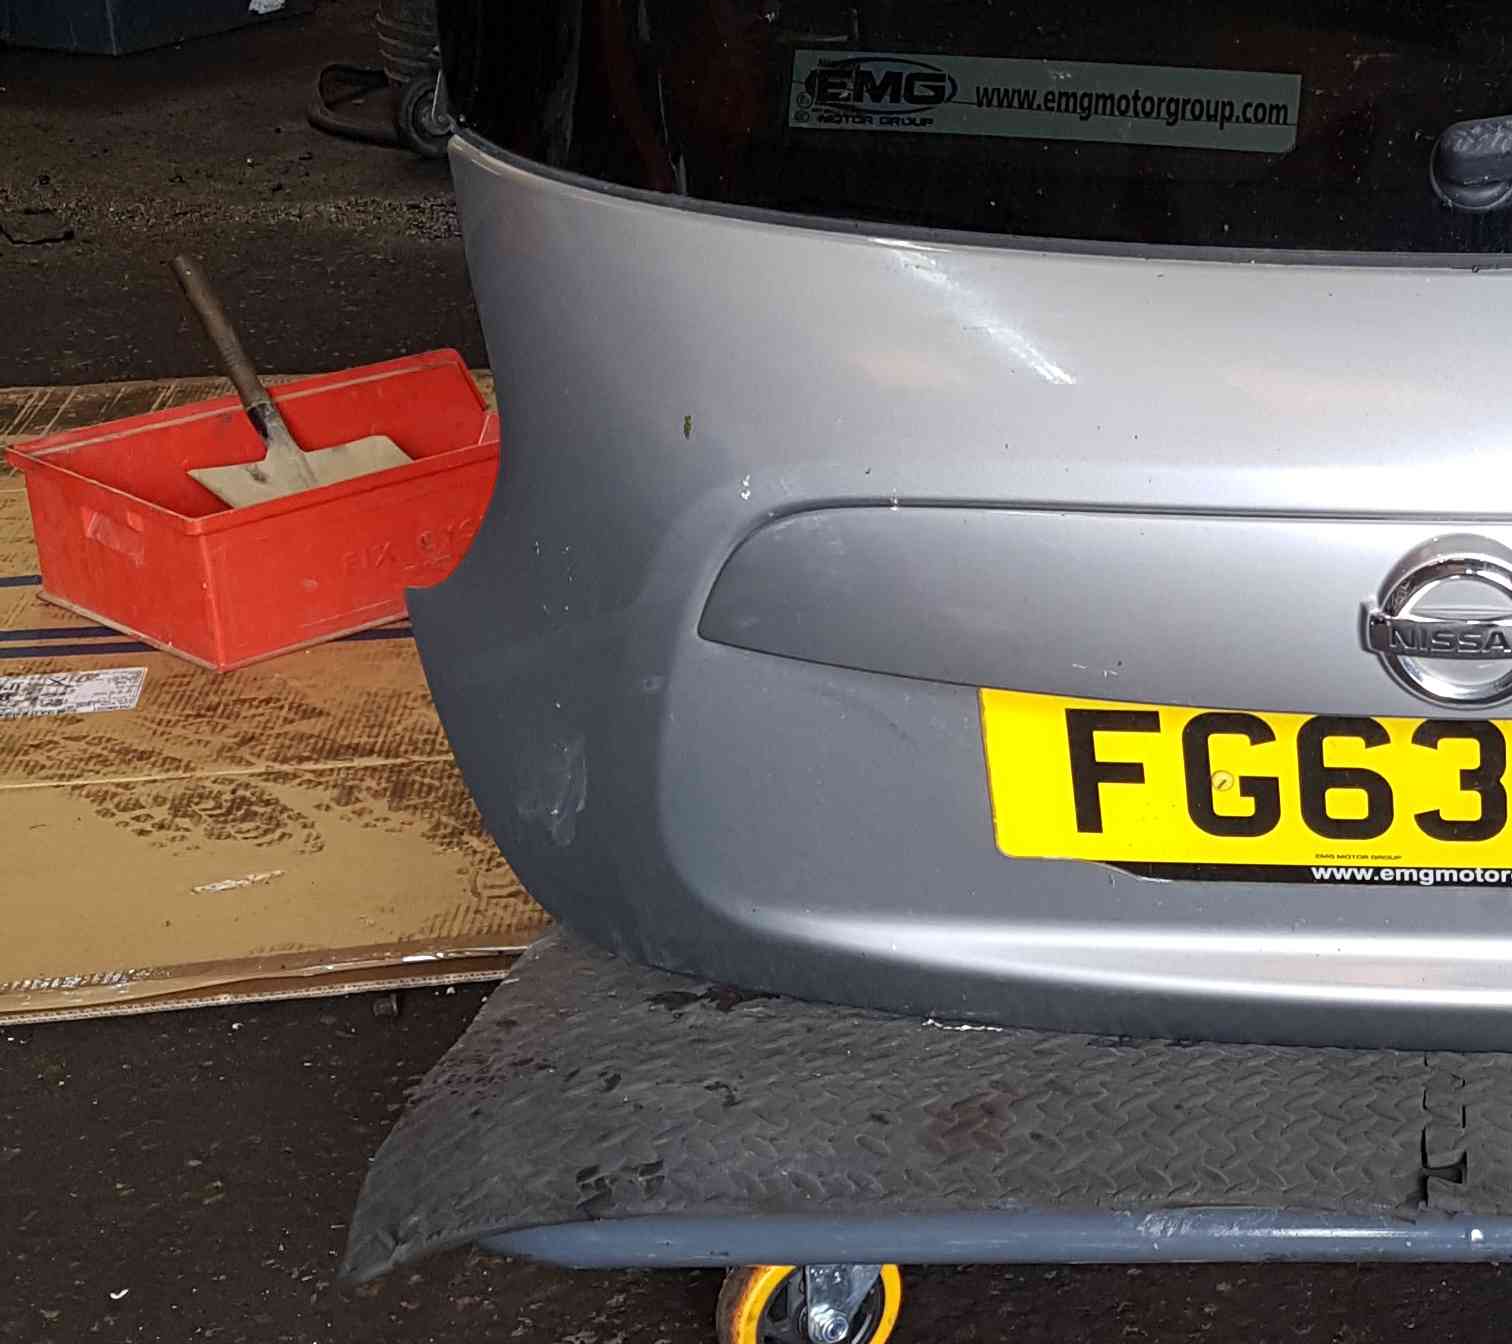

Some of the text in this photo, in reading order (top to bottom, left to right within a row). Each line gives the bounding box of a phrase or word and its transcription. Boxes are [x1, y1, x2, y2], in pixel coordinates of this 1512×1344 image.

[815, 67, 946, 105] EMG
[974, 82, 1290, 129] www.emgmotorgroup.com
[1064, 707, 1509, 842] FG63
